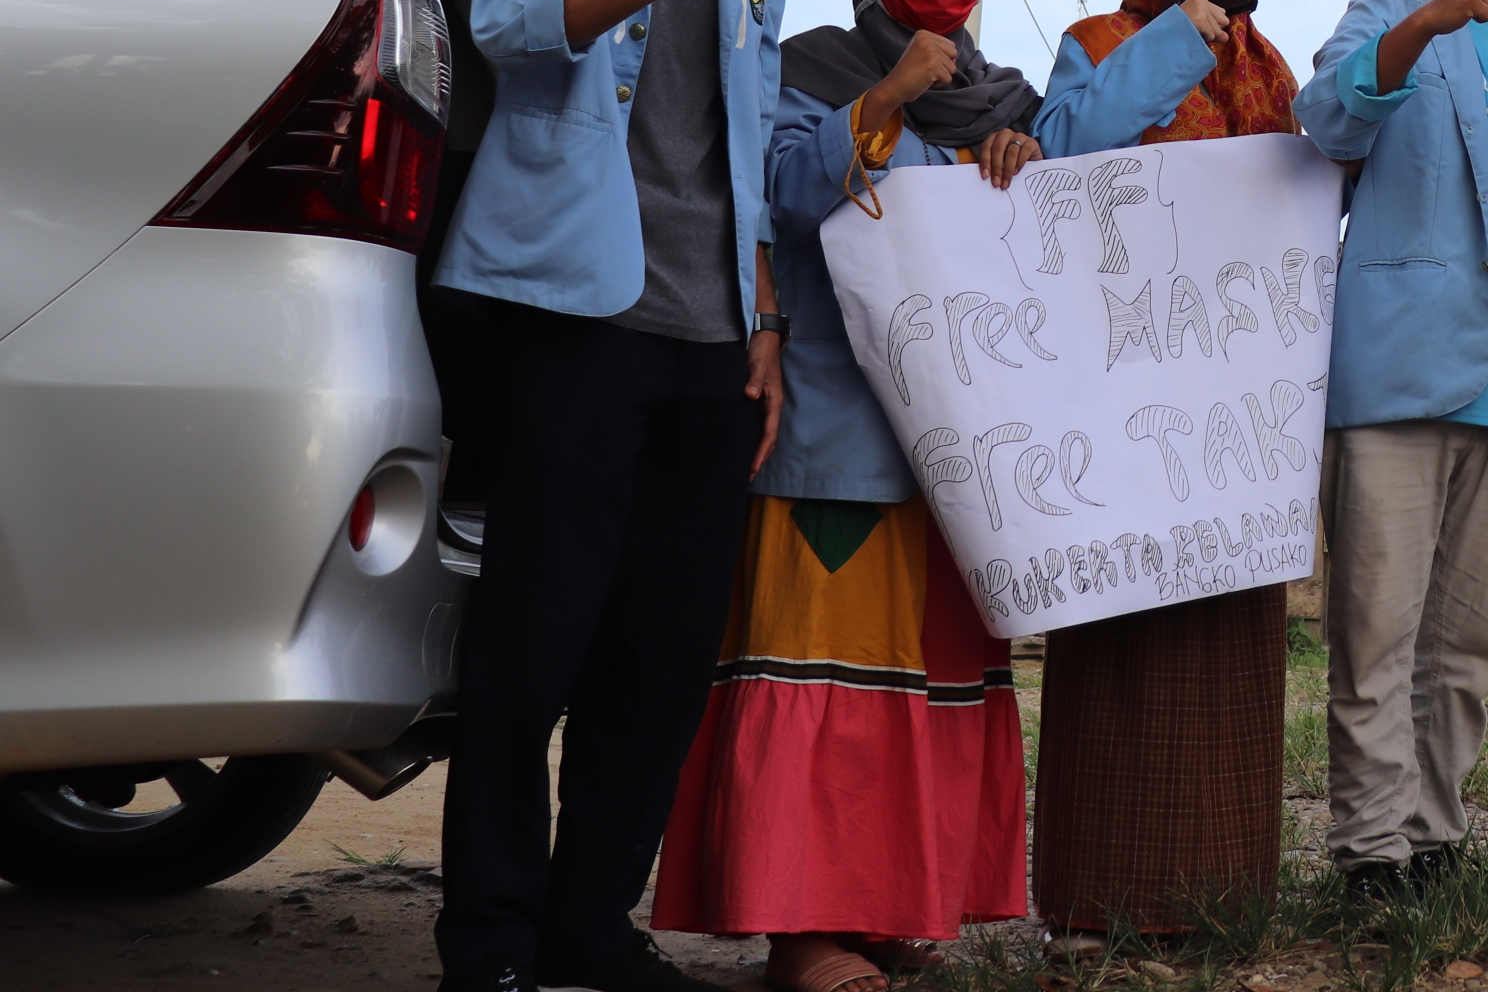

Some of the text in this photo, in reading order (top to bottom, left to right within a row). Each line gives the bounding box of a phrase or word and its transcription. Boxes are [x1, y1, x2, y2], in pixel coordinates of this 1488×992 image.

[967, 532, 1164, 624] KUKERTA
[1154, 544, 1308, 602] BANGKO PUSAKO
